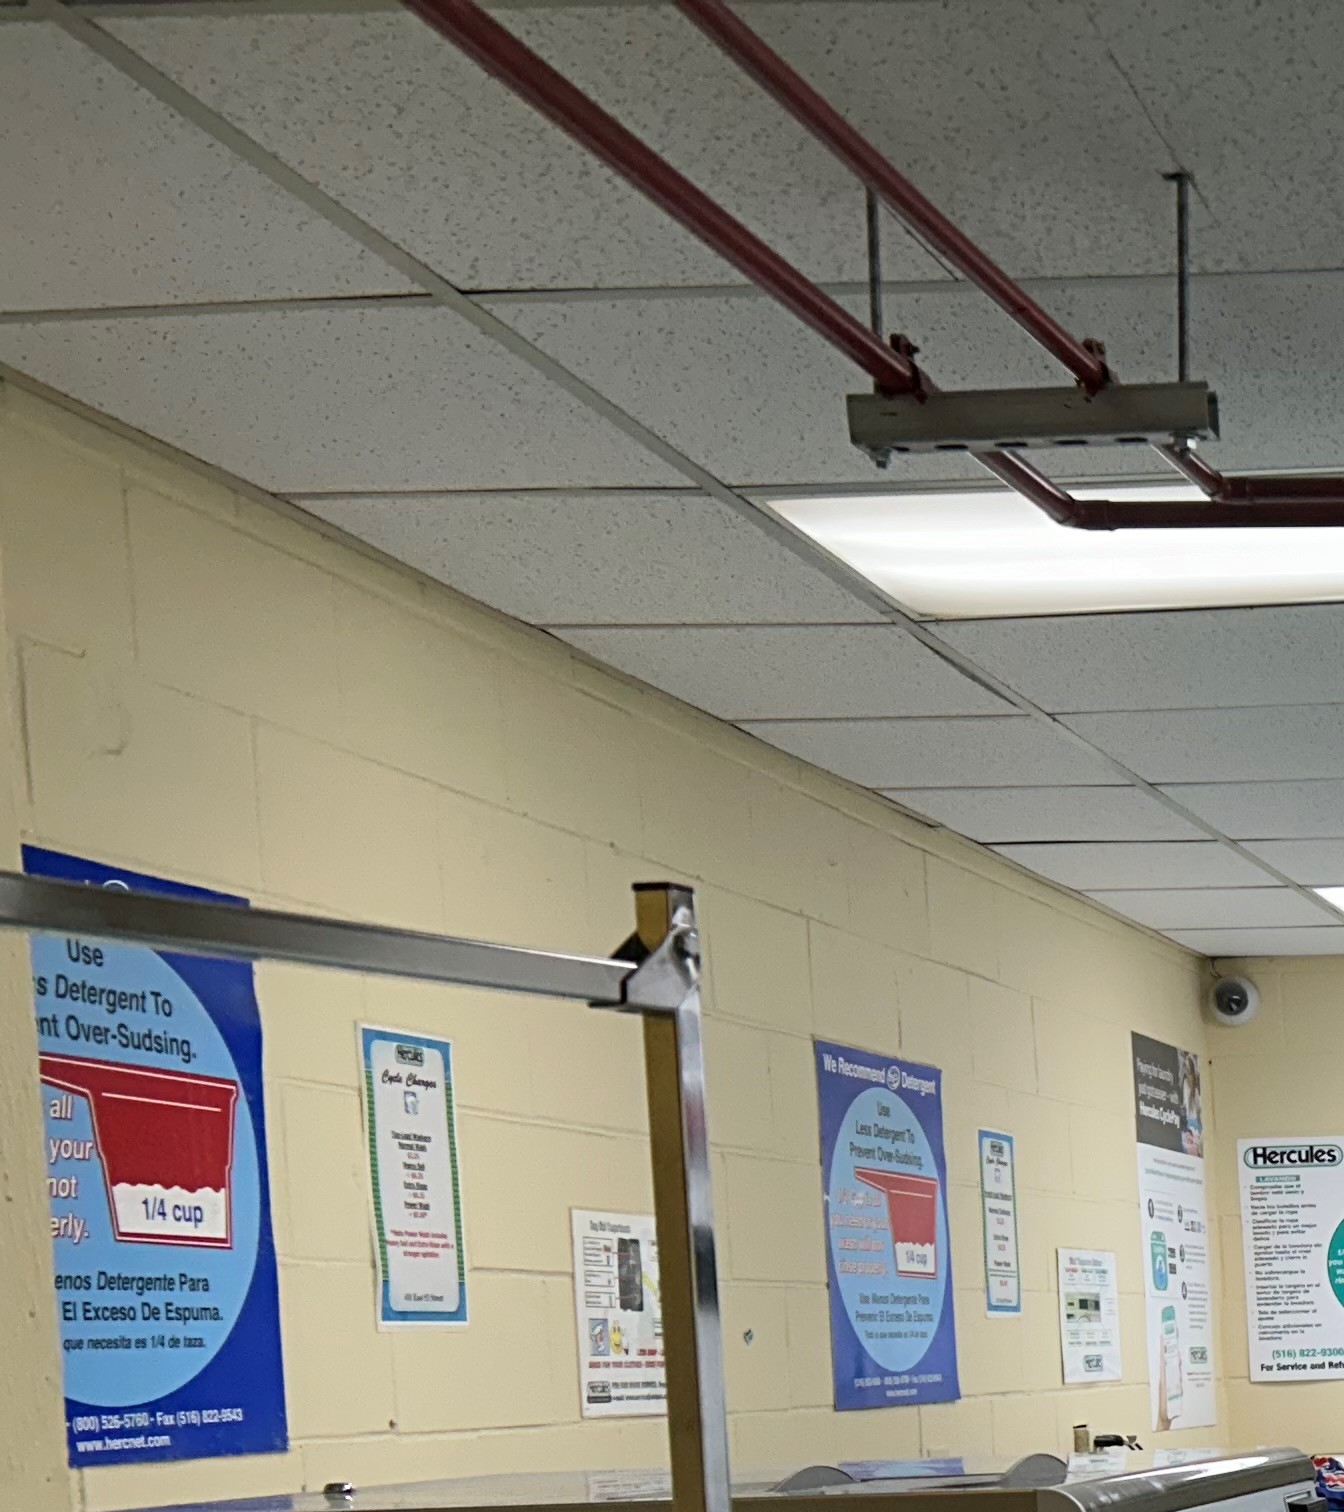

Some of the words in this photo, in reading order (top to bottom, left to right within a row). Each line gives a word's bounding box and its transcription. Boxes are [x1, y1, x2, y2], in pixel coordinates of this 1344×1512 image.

[66, 938, 104, 967] Use
[55, 974, 147, 1014] Detergent
[150, 991, 173, 1018] To
[65, 1014, 196, 1064] Over-Sudsing.
[823, 1053, 837, 1073] We
[838, 1057, 886, 1084] Recommend
[902, 1071, 936, 1096] Detergent
[49, 1097, 73, 1120] all
[49, 1138, 94, 1164] your
[1252, 1145, 1337, 1165] Hercules
[141, 1197, 167, 1221] 1/4
[172, 1203, 204, 1228] cup
[1328, 1259, 1344, 1267] you
[97, 1271, 176, 1296] Detergente
[178, 1273, 210, 1293] Para
[62, 1301, 77, 1322] El
[83, 1302, 137, 1322] Exceso
[141, 1301, 161, 1321] De
[165, 1302, 224, 1326] Espuma.
[63, 1336, 84, 1351] que
[87, 1334, 132, 1350] necesita
[135, 1336, 147, 1349] es
[151, 1334, 165, 1349] 1/4
[168, 1334, 181, 1348] de
[1272, 1349, 1297, 1361] (516)
[1299, 1347, 1344, 1358] 822-9300
[1260, 1363, 1274, 1372] For
[1276, 1361, 1308, 1372] Service
[1310, 1361, 1326, 1370] and
[73, 1414, 100, 1435] (800)
[156, 1412, 175, 1427] Fax
[176, 1410, 200, 1427] (516)
[76, 1434, 171, 1453] www.hercnet.com
